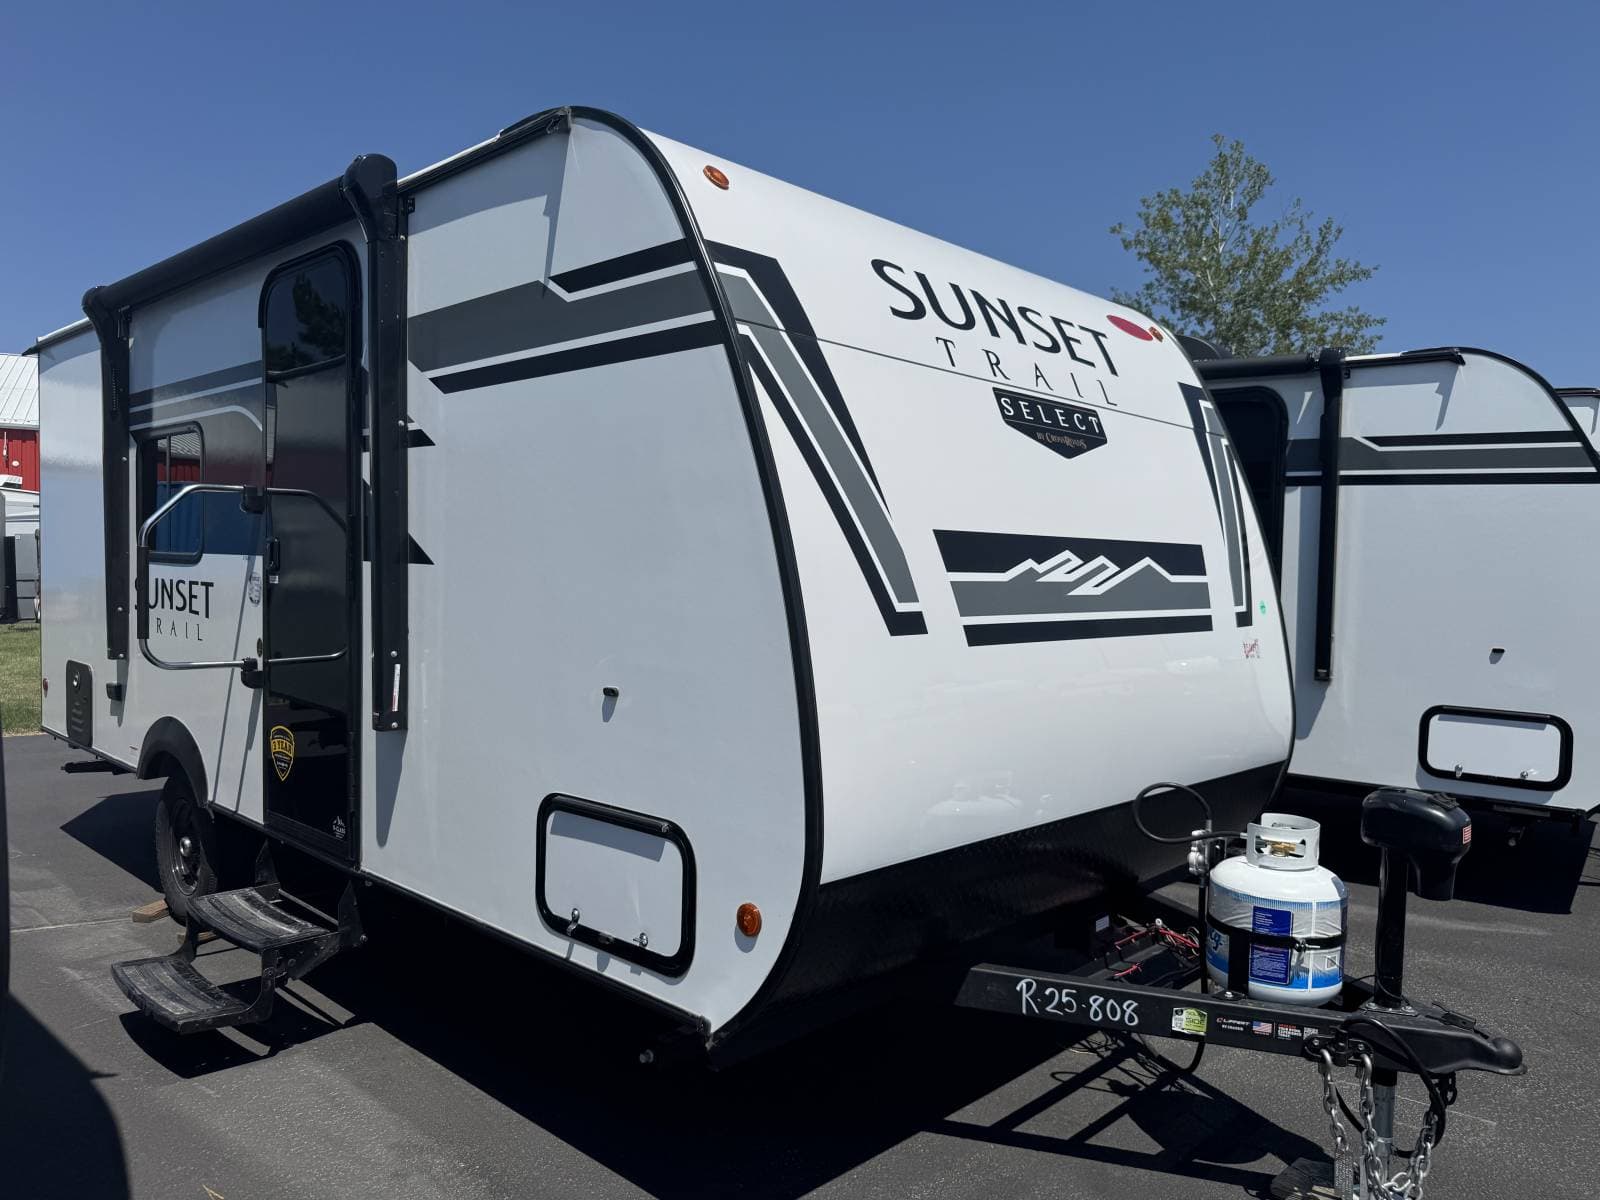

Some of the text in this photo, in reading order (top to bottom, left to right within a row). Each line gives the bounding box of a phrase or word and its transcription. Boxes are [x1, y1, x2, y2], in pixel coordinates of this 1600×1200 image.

[870, 258, 1119, 377] SUNSET
[936, 336, 1118, 406] TRAIL
[1000, 397, 1100, 434] SELECT
[156, 617, 203, 642] RAIL
